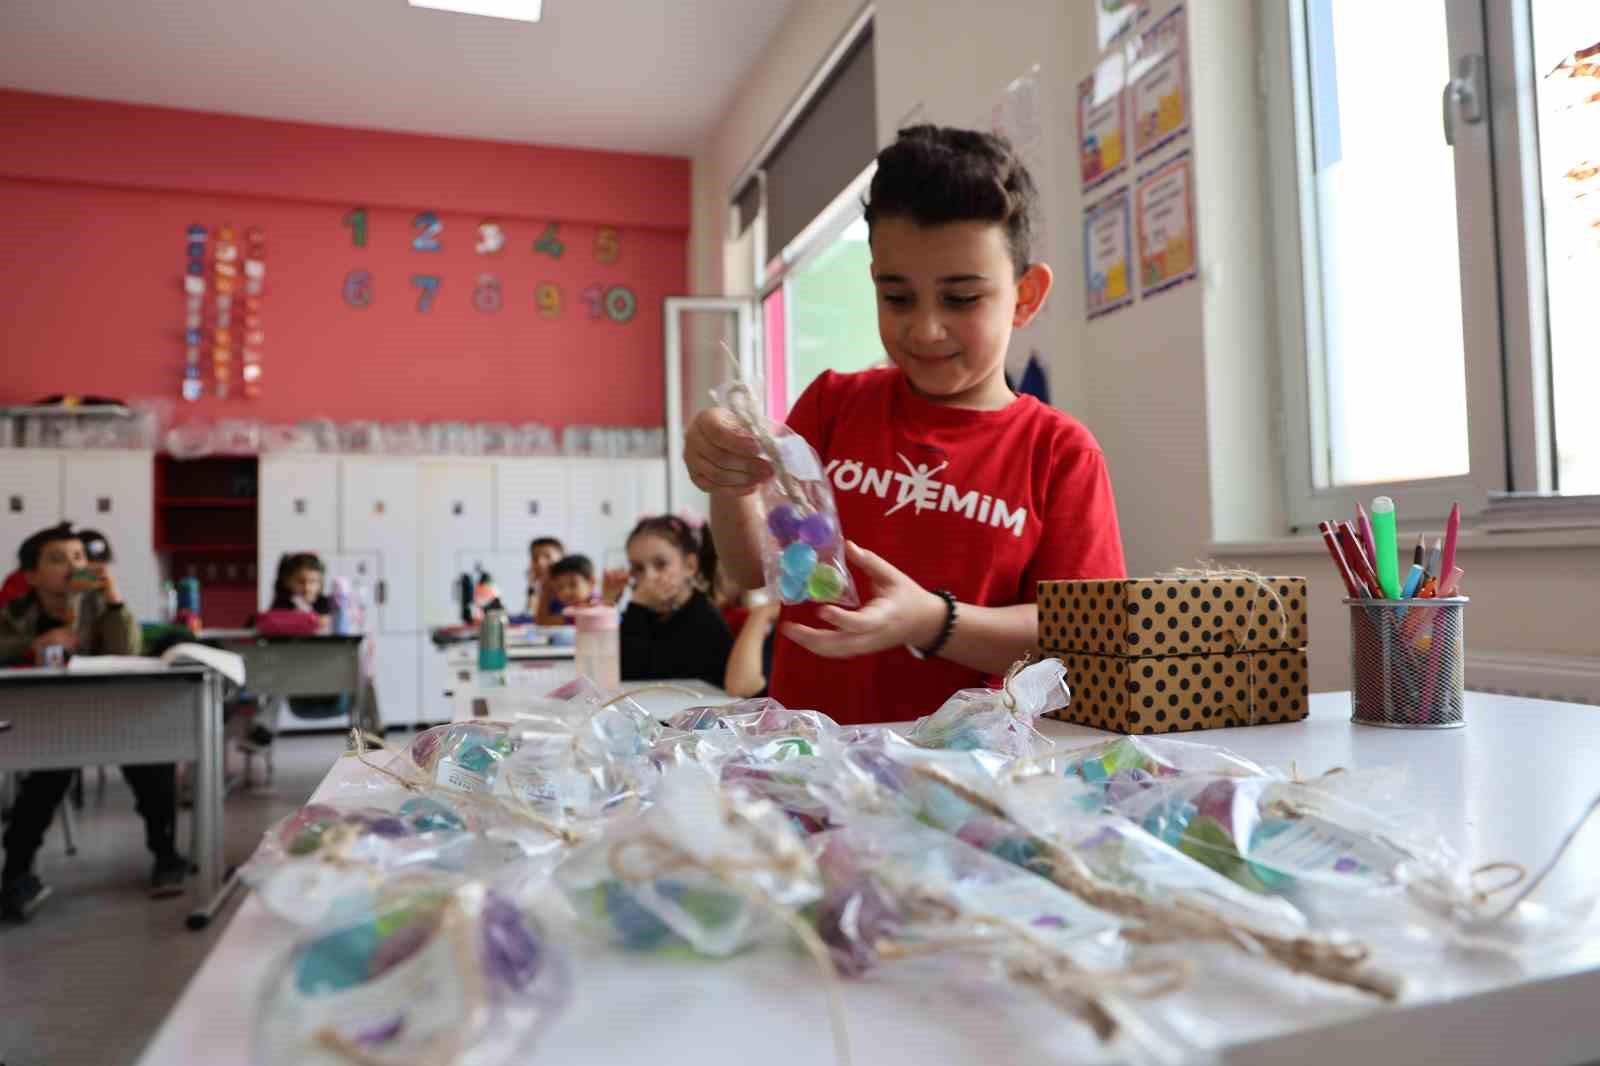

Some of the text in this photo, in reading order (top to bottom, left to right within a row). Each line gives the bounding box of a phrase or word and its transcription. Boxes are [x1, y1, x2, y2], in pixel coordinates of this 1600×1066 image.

[344, 208, 619, 263] 1 2 3 4 5
[342, 271, 636, 323] 6 7 8 9 10
